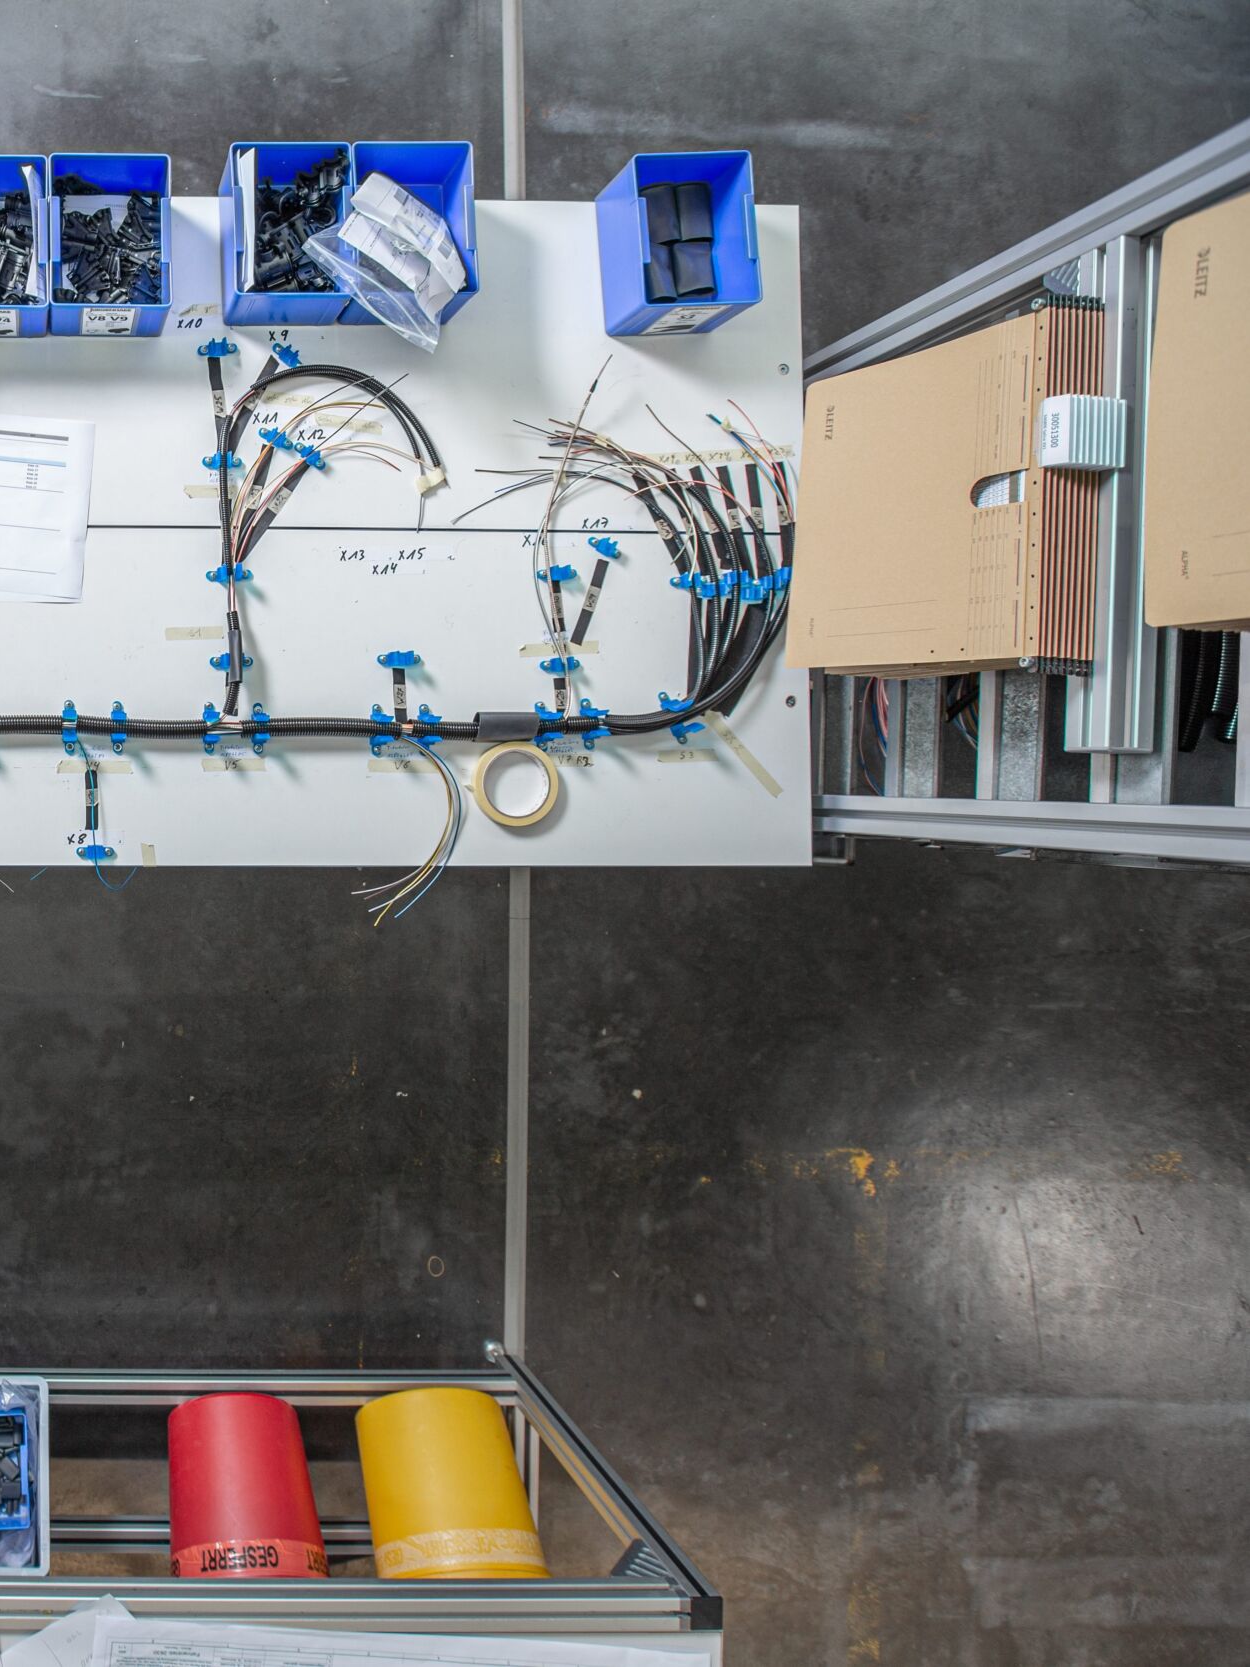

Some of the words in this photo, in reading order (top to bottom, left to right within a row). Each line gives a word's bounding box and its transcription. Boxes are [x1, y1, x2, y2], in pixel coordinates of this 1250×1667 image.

[1194, 258, 1209, 299] LEITZ
[177, 318, 203, 329] X10
[252, 412, 279, 425] X11
[824, 412, 834, 441] LEITZ
[1050, 412, 1060, 448] 30051300
[297, 429, 326, 441] X12
[581, 517, 609, 529] X17
[339, 549, 365, 562] X13
[398, 547, 426, 560] X15
[372, 563, 397, 575] X14
[679, 750, 695, 760] S3
[224, 758, 242, 771] V5
[394, 759, 411, 770] V6
[200, 1545, 279, 1573] GESPERRT
